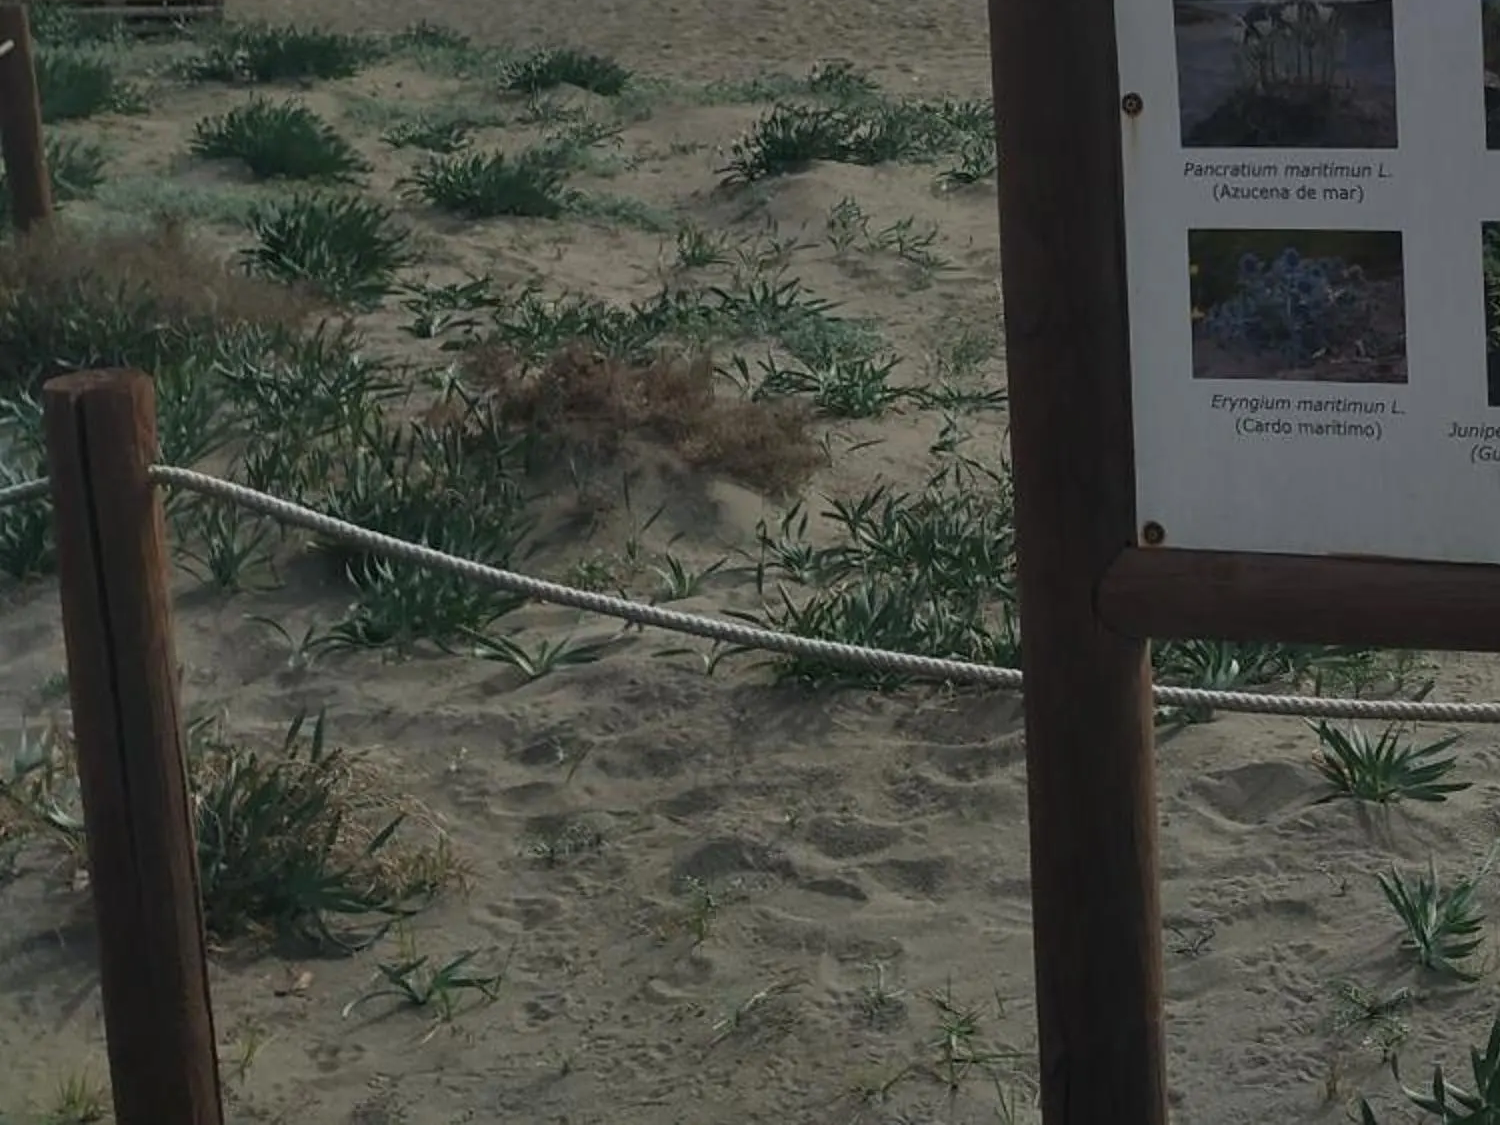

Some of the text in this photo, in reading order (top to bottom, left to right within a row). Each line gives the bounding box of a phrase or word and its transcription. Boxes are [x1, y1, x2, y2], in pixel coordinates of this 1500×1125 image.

[1183, 161, 1279, 178] Pancratium
[1212, 183, 1365, 204] (Azucena de mar)
[1210, 393, 1292, 414] Eryngium
[1235, 416, 1293, 436] (Cardo
